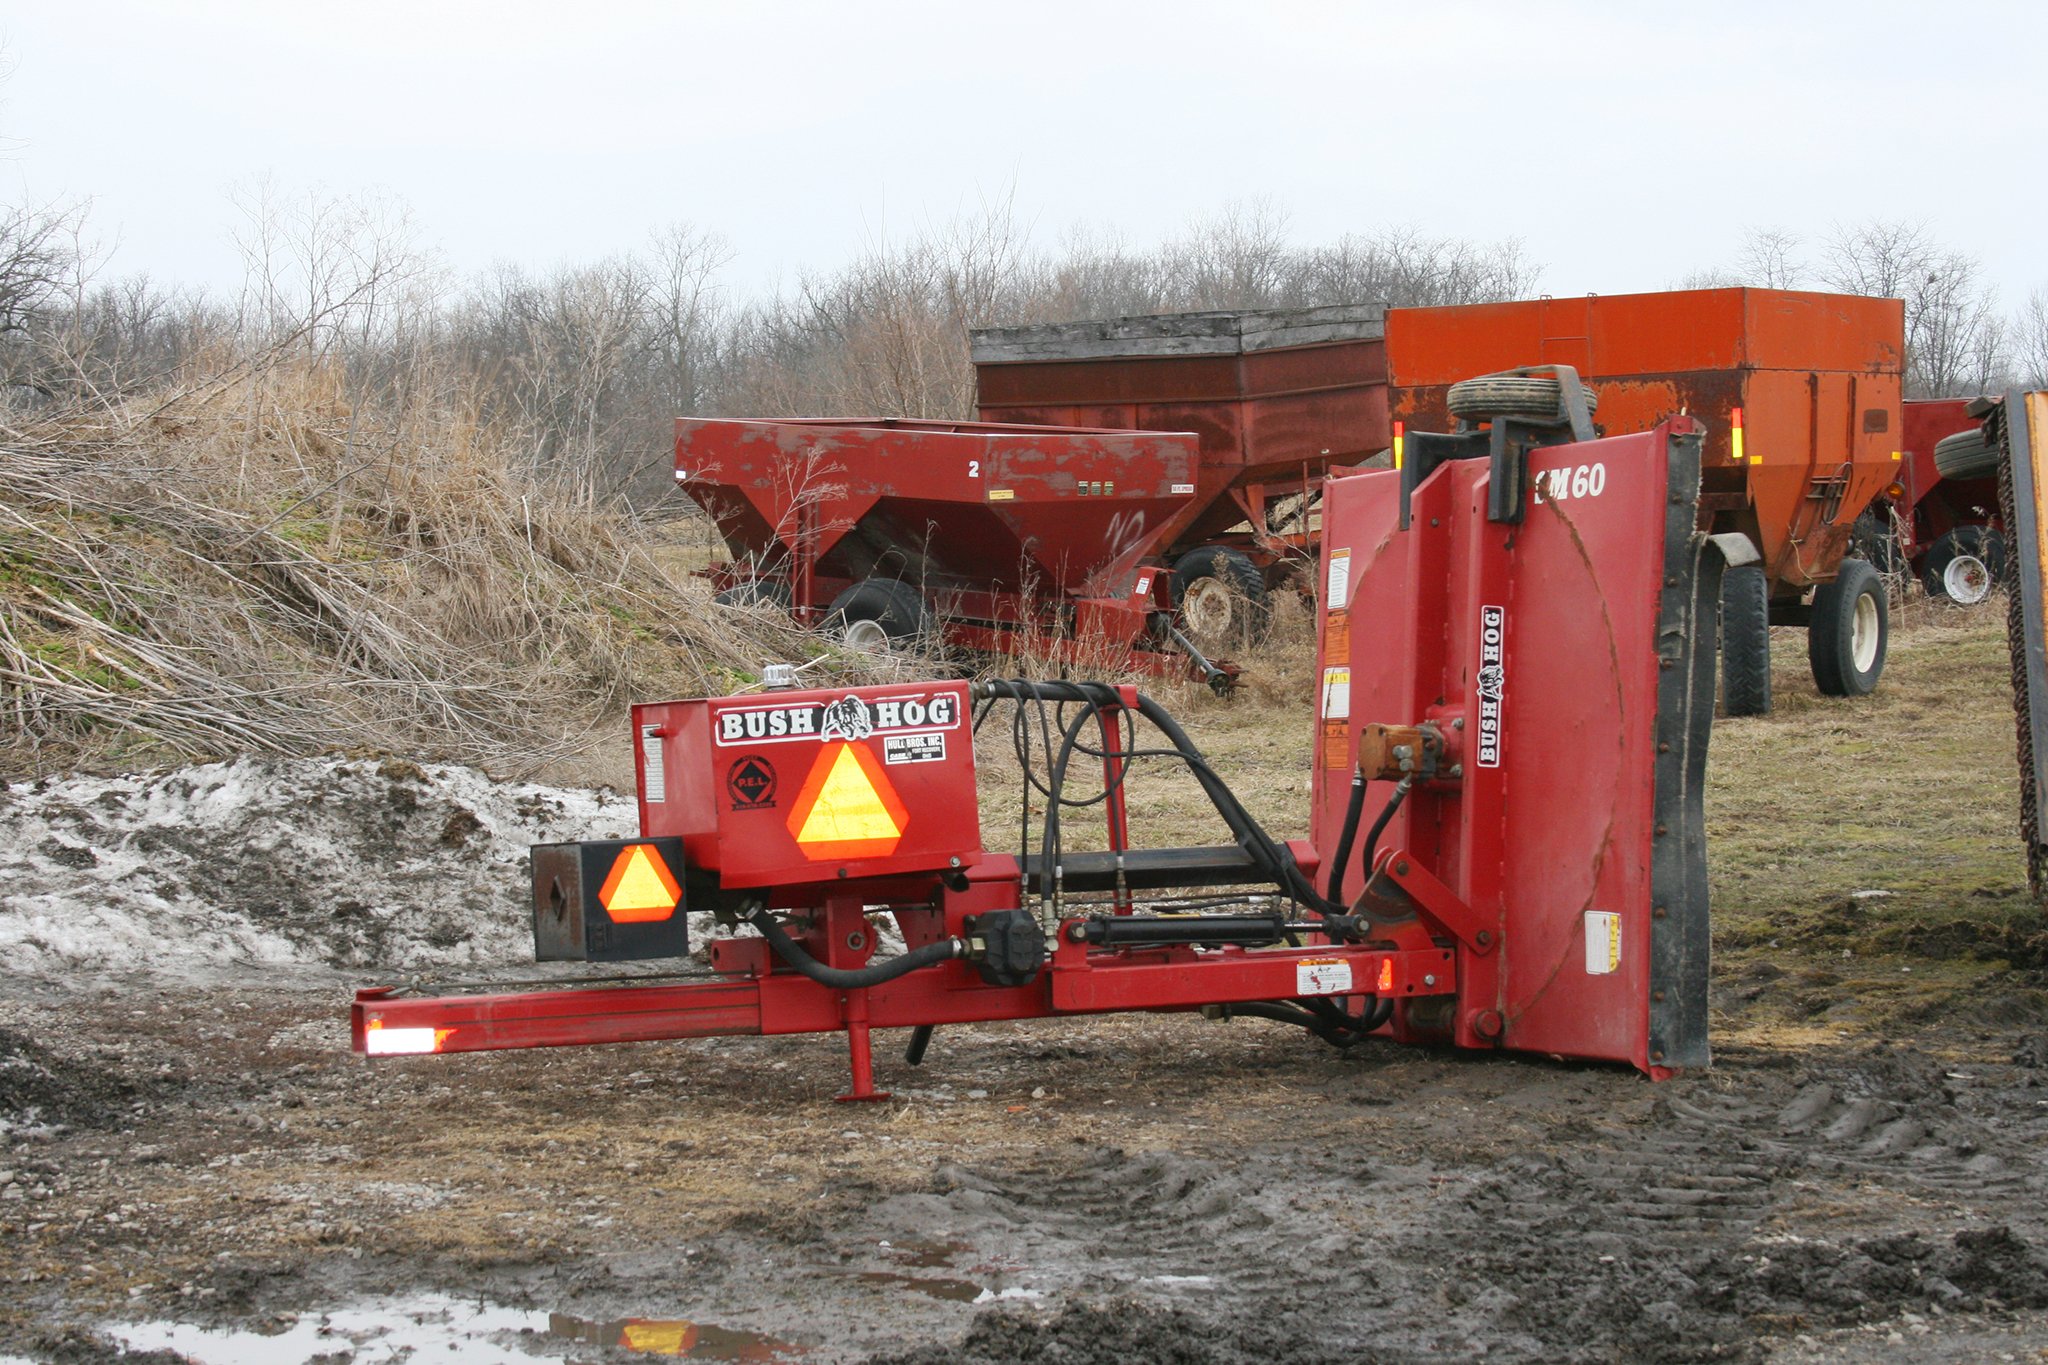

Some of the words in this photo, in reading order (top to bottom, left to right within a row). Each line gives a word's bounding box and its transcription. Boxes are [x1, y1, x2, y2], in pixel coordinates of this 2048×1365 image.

[968, 460, 979, 478] 2
[1484, 612, 1501, 661] HOG
[721, 708, 815, 740] BUSH
[876, 698, 951, 728] HOG
[1480, 702, 1498, 762] BUSH
[888, 739, 905, 749] HULL
[906, 738, 927, 748] BROS.
[928, 736, 942, 746] INC.
